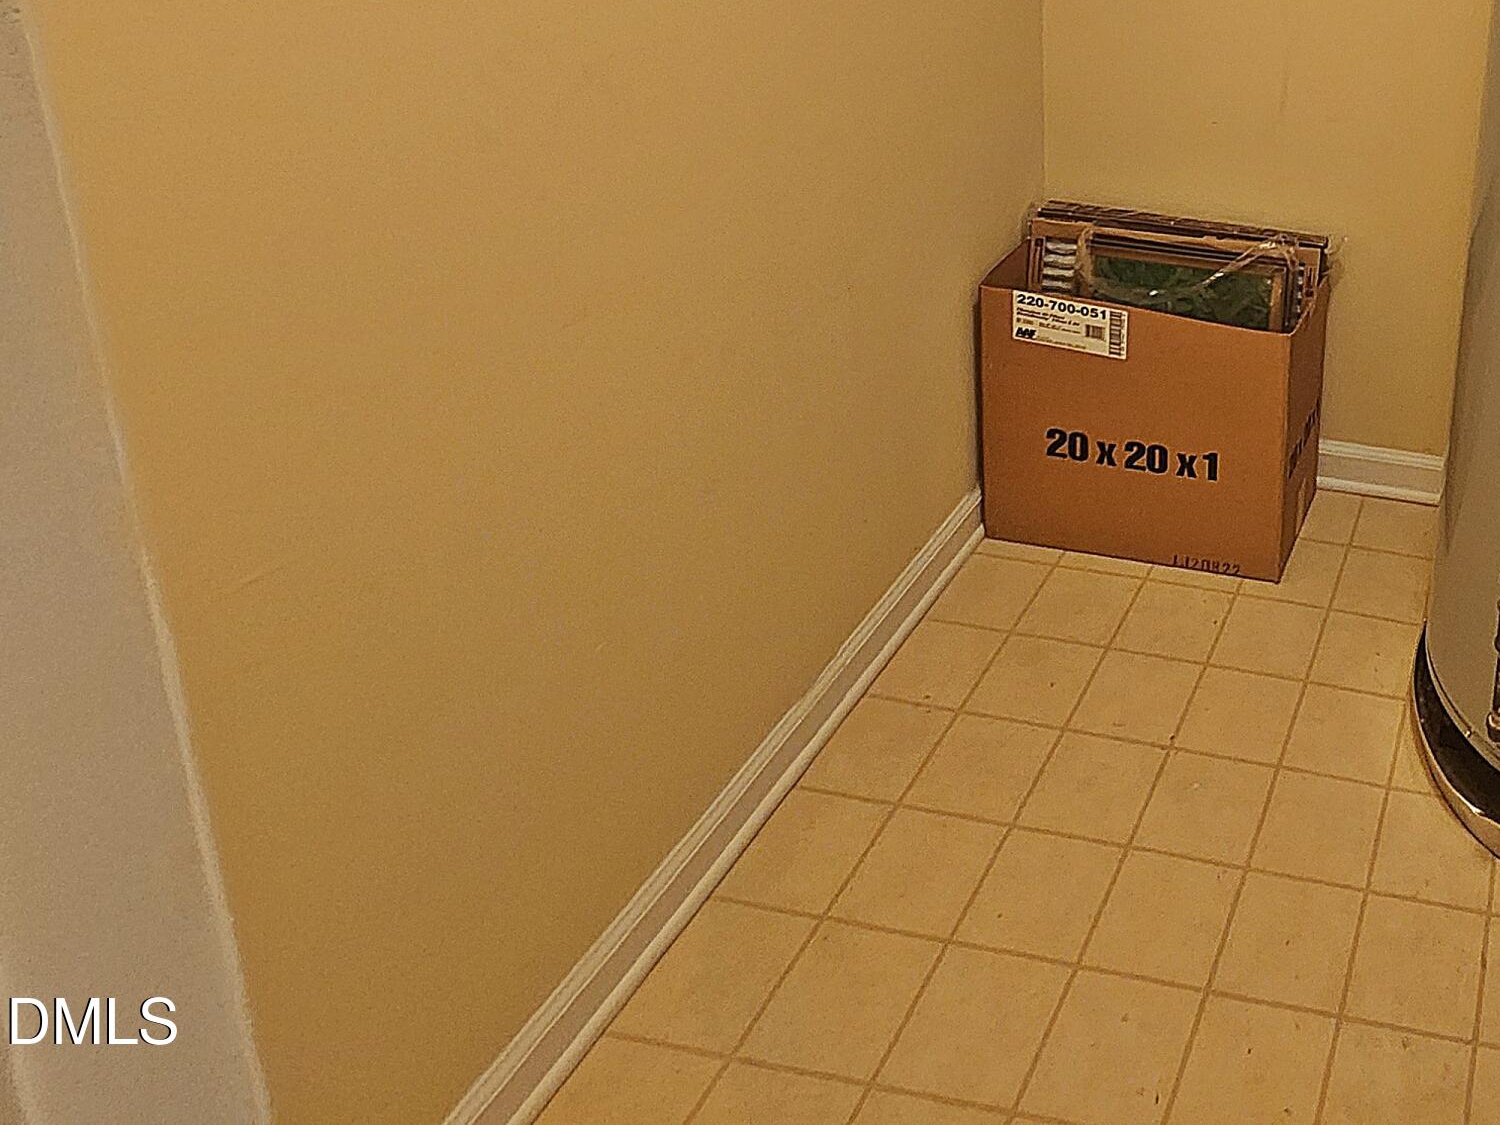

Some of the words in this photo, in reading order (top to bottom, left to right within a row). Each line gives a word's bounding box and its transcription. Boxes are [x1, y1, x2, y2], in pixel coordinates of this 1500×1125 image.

[1016, 293, 1107, 321] 220-700-051
[1046, 427, 1090, 463] 20
[1095, 440, 1118, 468] x
[1123, 440, 1169, 475] 20
